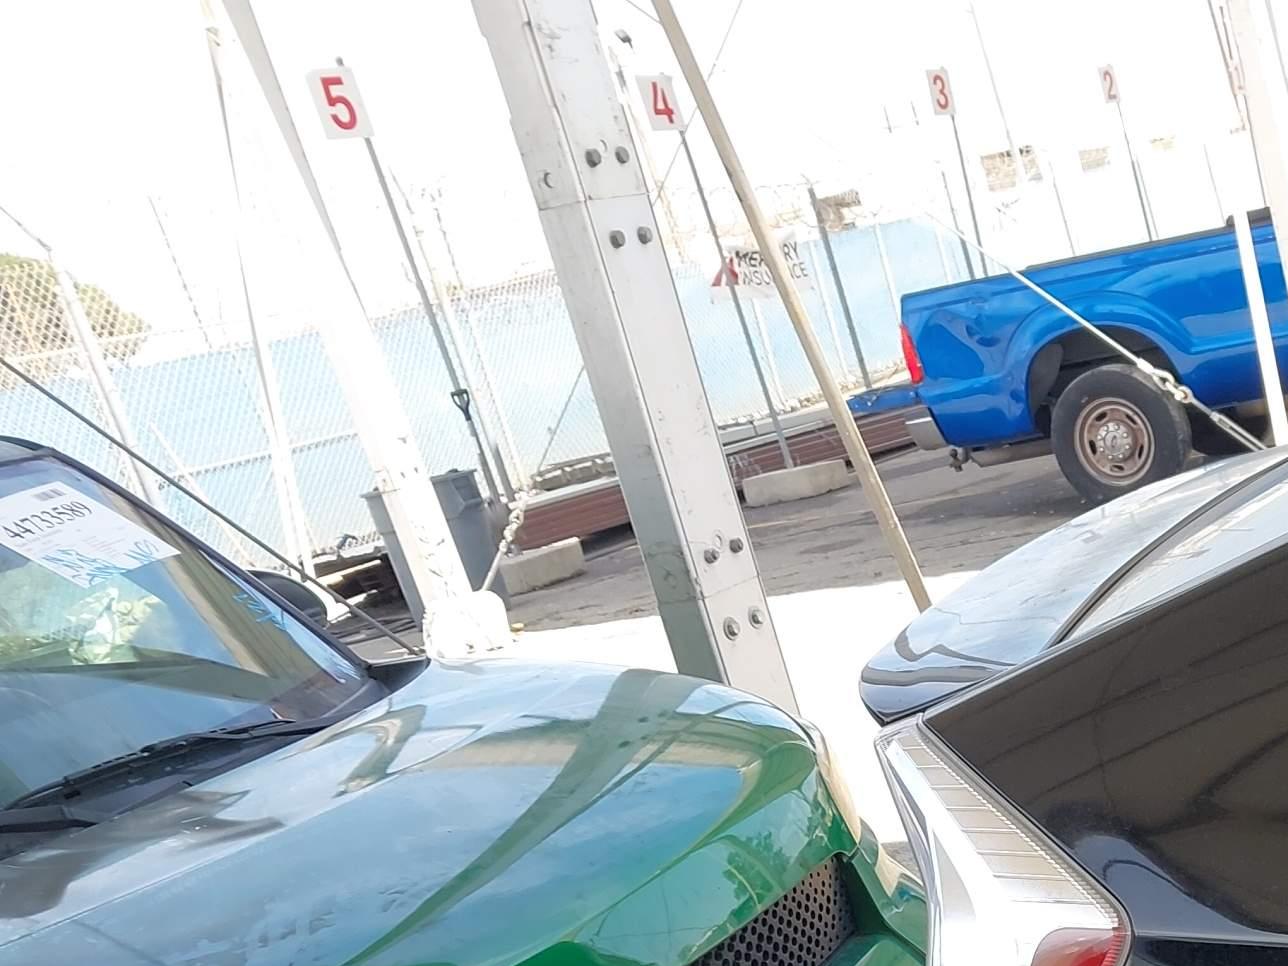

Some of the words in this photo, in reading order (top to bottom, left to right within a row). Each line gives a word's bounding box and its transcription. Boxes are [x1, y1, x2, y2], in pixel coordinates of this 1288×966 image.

[320, 76, 357, 130] 5
[651, 81, 674, 124] 4
[933, 74, 949, 110] 3
[1103, 70, 1117, 100] 2
[735, 241, 800, 268] MERY
[1, 500, 93, 539] 44733589
